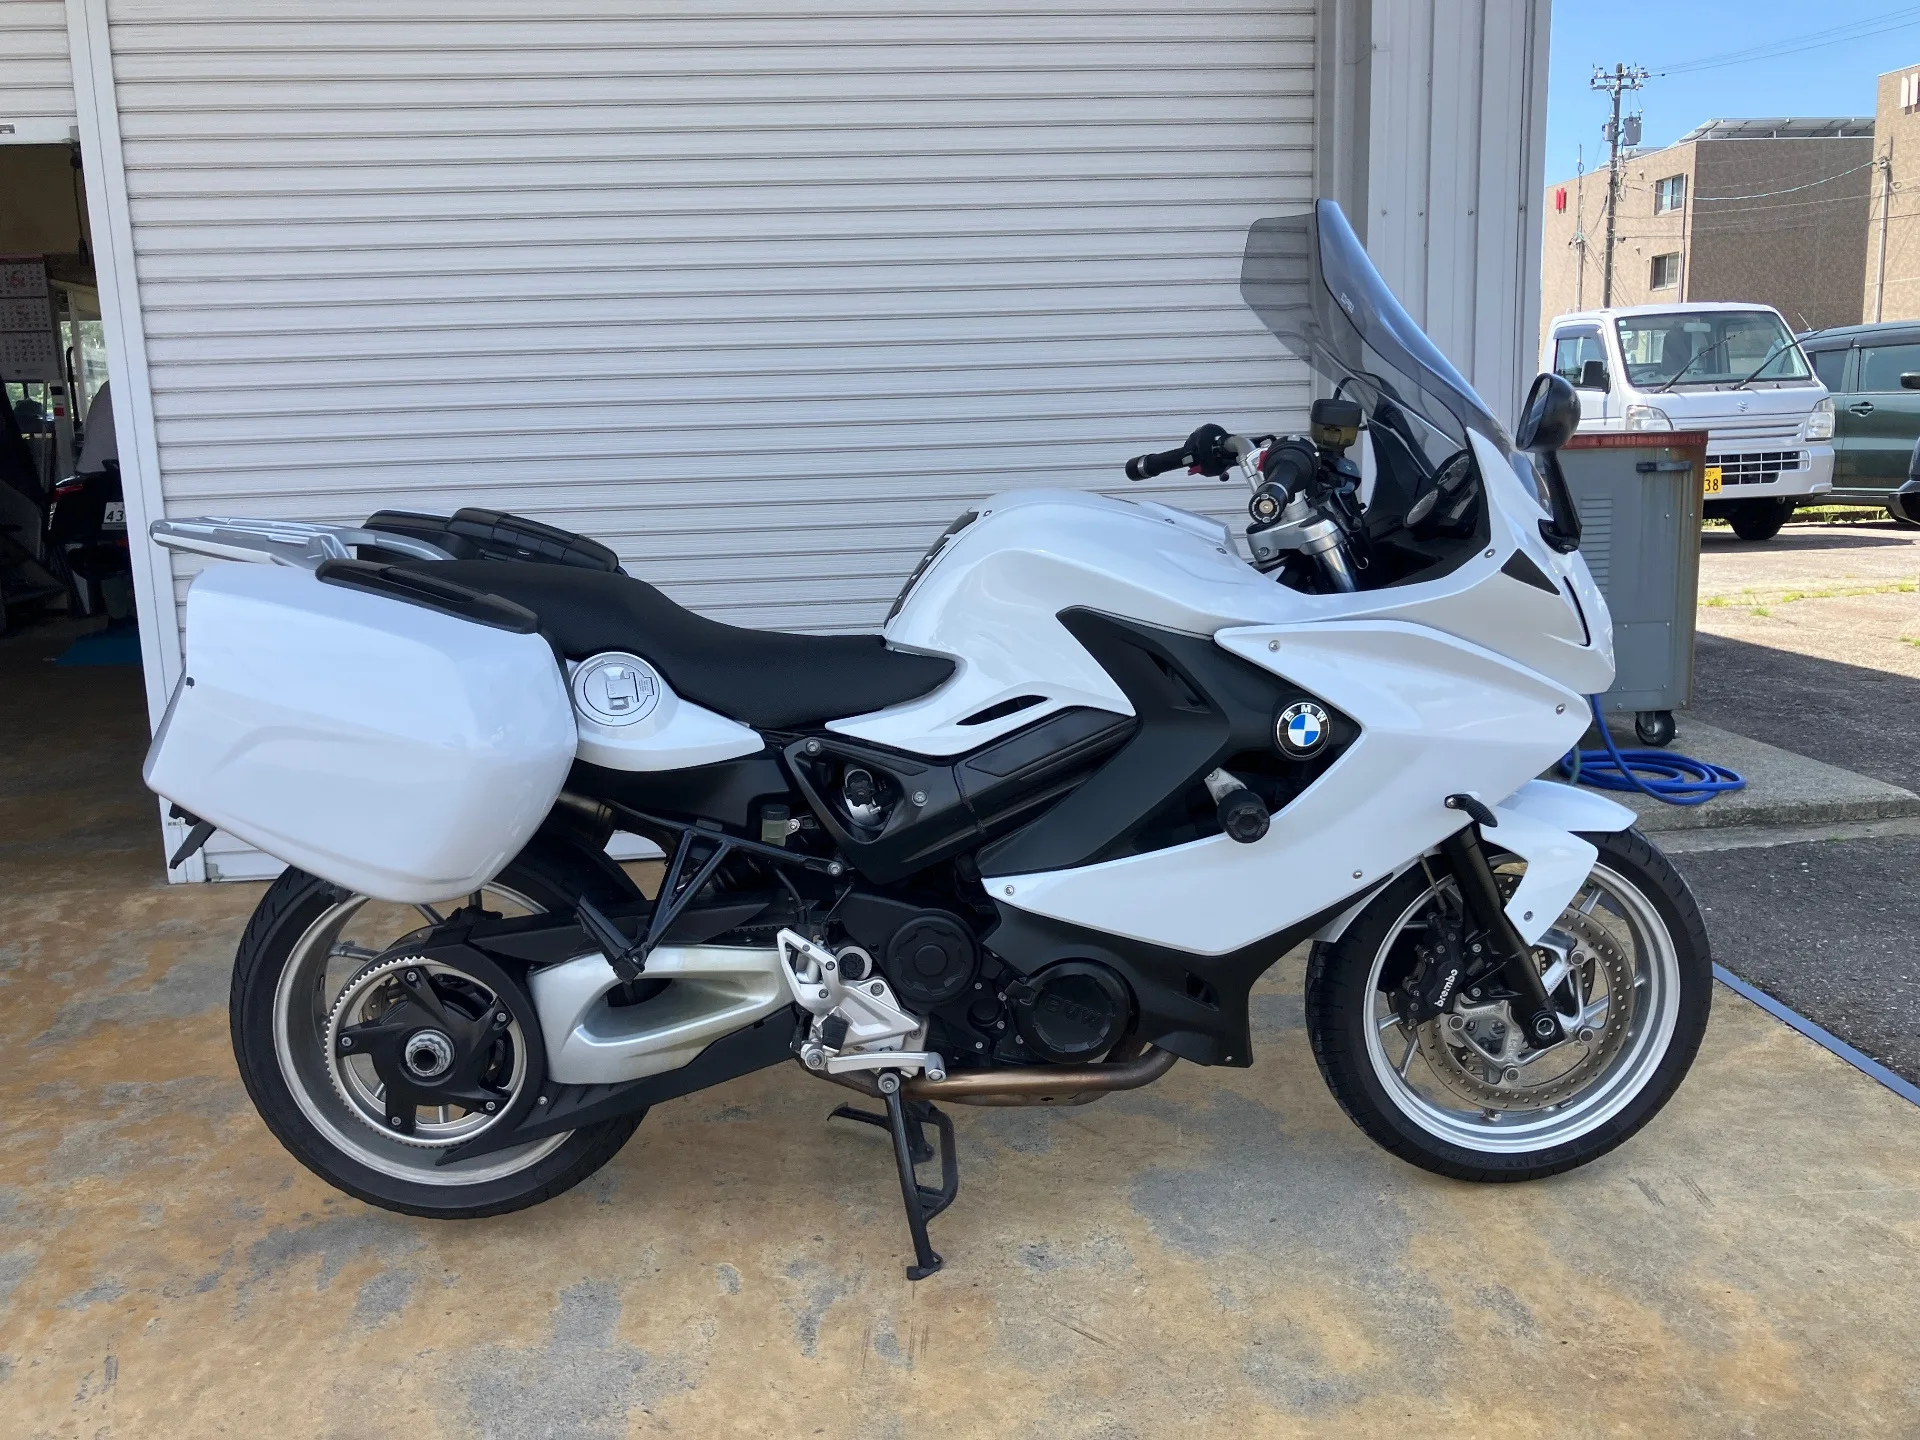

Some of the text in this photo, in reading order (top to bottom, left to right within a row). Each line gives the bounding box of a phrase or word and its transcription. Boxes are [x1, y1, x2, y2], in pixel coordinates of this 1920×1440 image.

[106, 510, 124, 522] 43
[1283, 704, 1328, 723] BMW
[1434, 968, 1459, 1008] brembo
